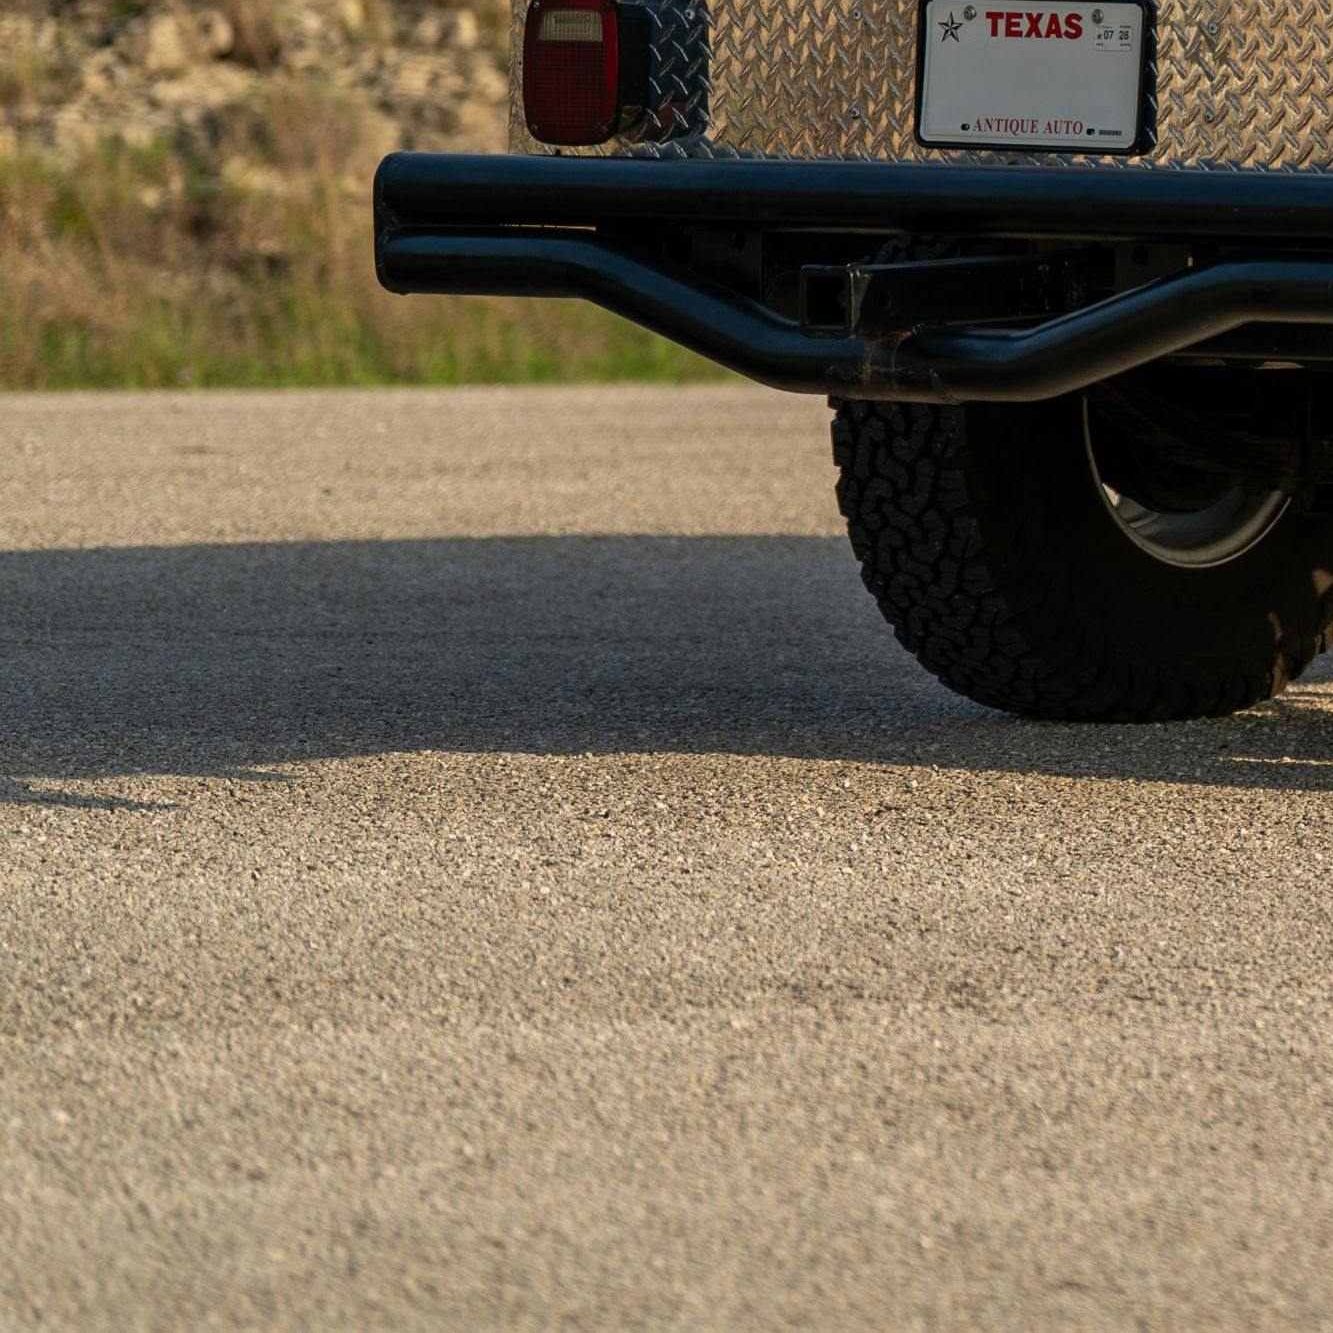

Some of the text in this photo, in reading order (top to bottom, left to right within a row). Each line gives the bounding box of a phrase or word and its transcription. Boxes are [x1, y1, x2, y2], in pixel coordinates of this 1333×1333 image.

[985, 11, 1083, 40] TEXAS
[1103, 30, 1129, 41] 07 28
[973, 118, 1083, 137] ANTIQUE AUTO
